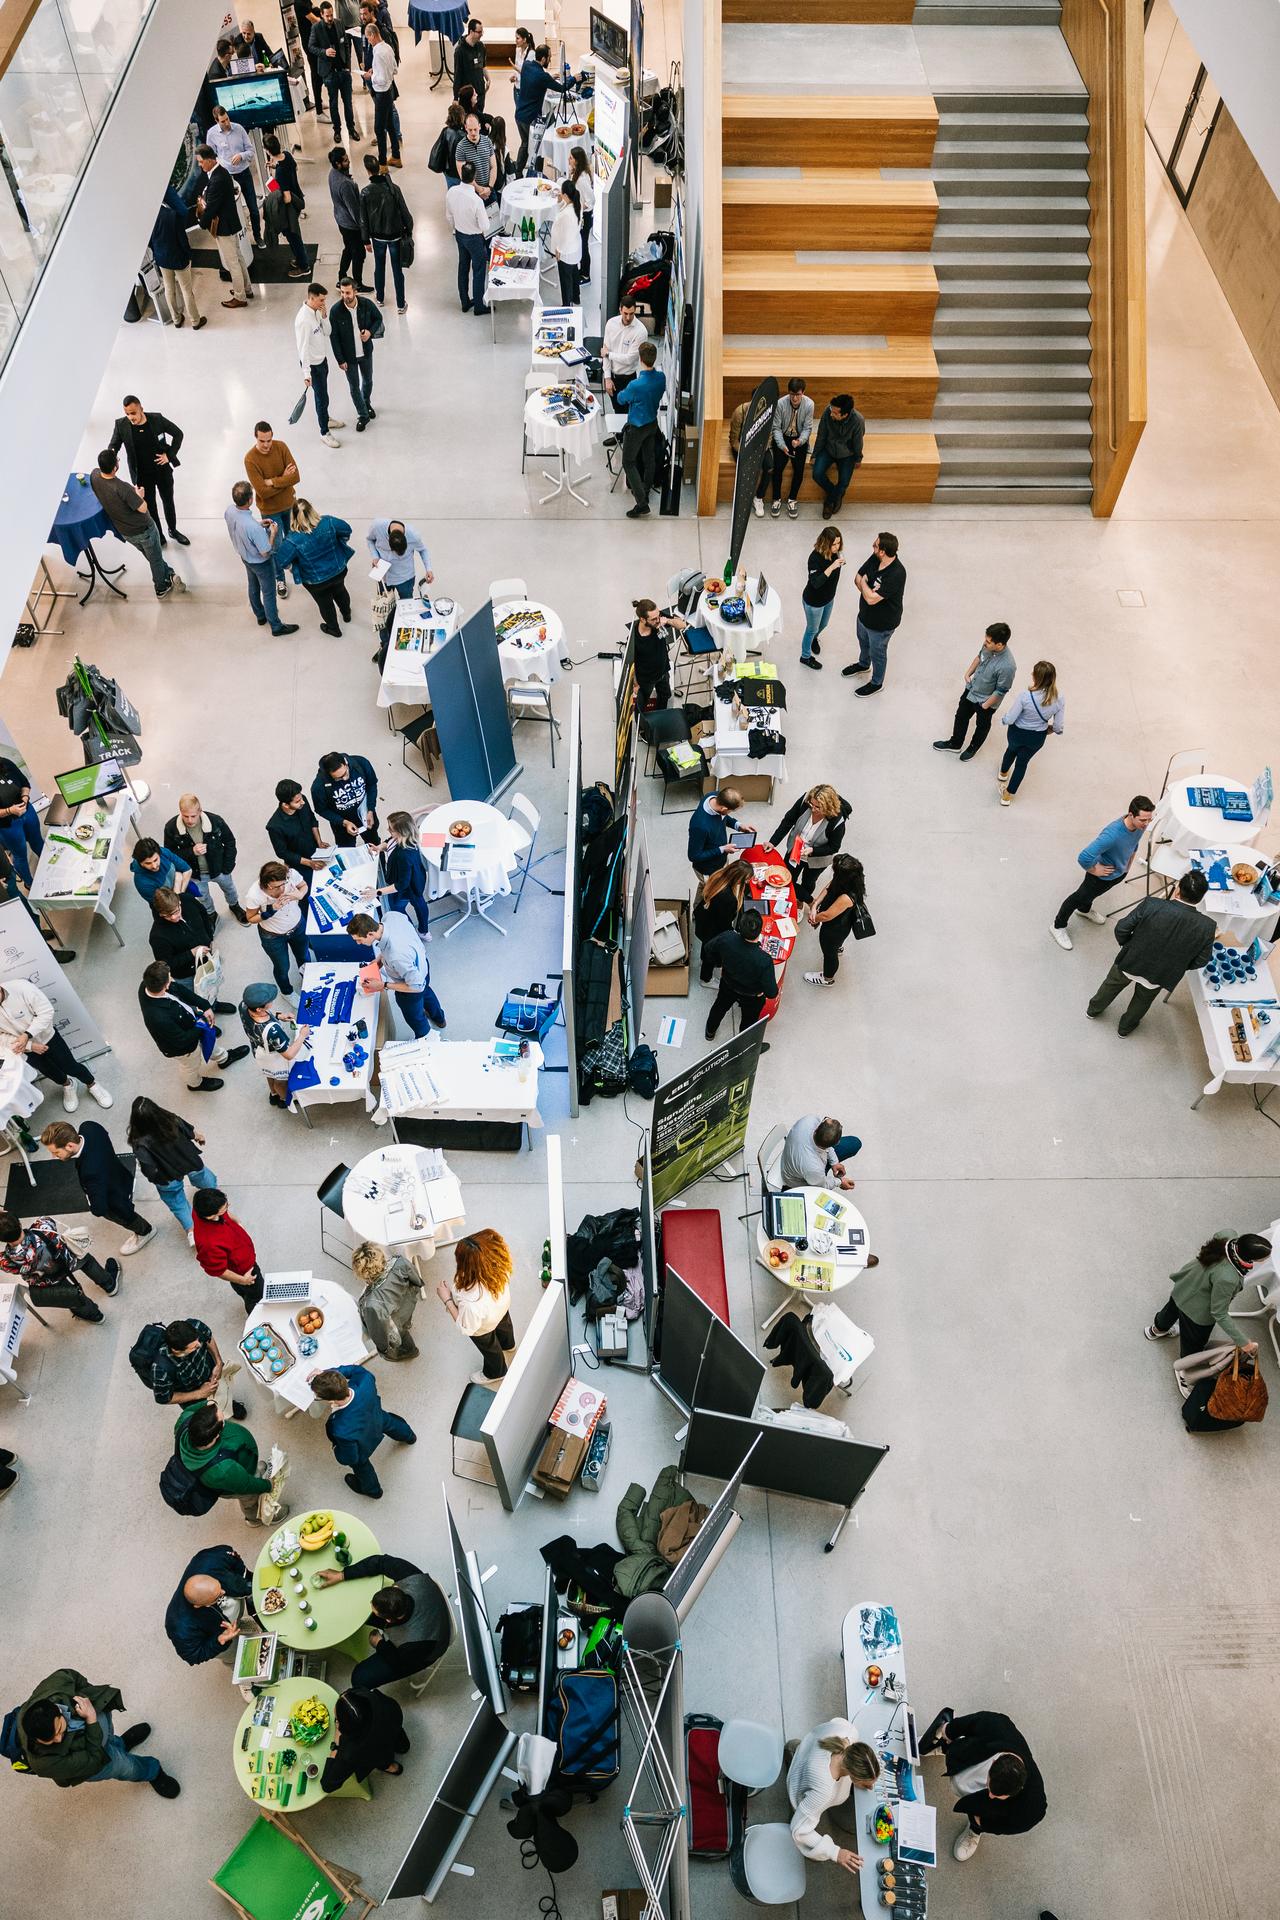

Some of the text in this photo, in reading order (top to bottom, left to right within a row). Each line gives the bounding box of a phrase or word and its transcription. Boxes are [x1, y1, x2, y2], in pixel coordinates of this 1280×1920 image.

[98, 748, 132, 761] TRACK
[333, 780, 356, 799] JACK
[692, 1053, 729, 1081] SOLUTIONS
[657, 1104, 695, 1132] Systems
[6, 1314, 21, 1350] mm1
